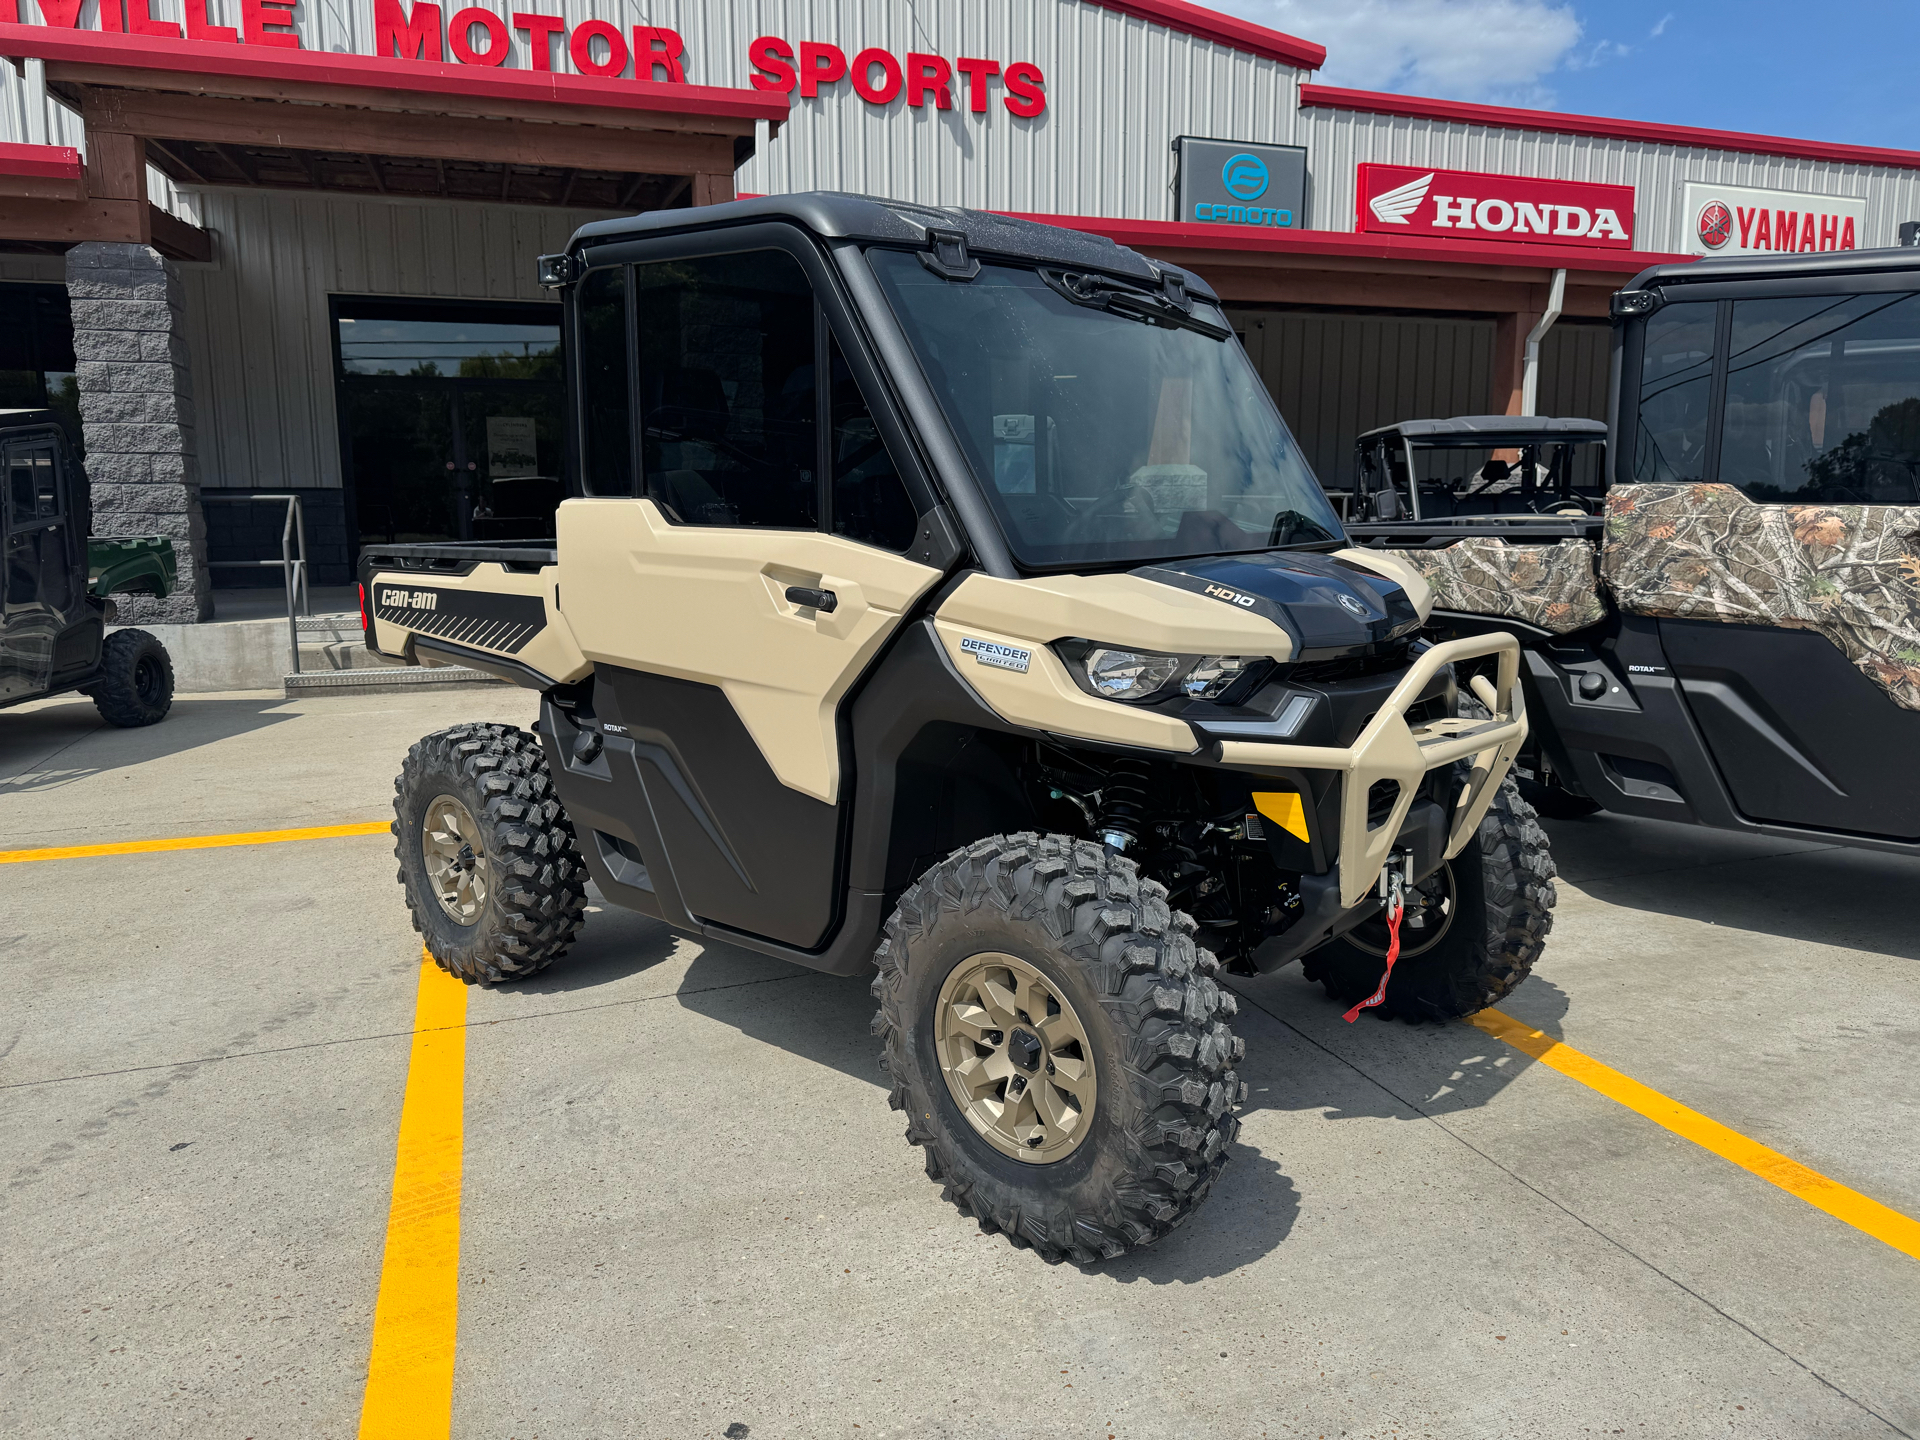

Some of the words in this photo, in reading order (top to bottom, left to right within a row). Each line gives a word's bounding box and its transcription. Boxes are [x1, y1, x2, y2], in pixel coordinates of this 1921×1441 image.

[0, 0, 299, 49] VILLE
[374, 0, 684, 84] MOTOR
[749, 36, 1046, 118] SPORTS
[1195, 203, 1292, 226] CFMOTO
[1432, 195, 1629, 240] HONDA
[1736, 206, 1856, 252] YAMAHA
[381, 589, 437, 610] can-am
[1204, 584, 1255, 606] HD10
[961, 638, 1029, 660] DEFENDER
[603, 723, 622, 732] ROTAX
